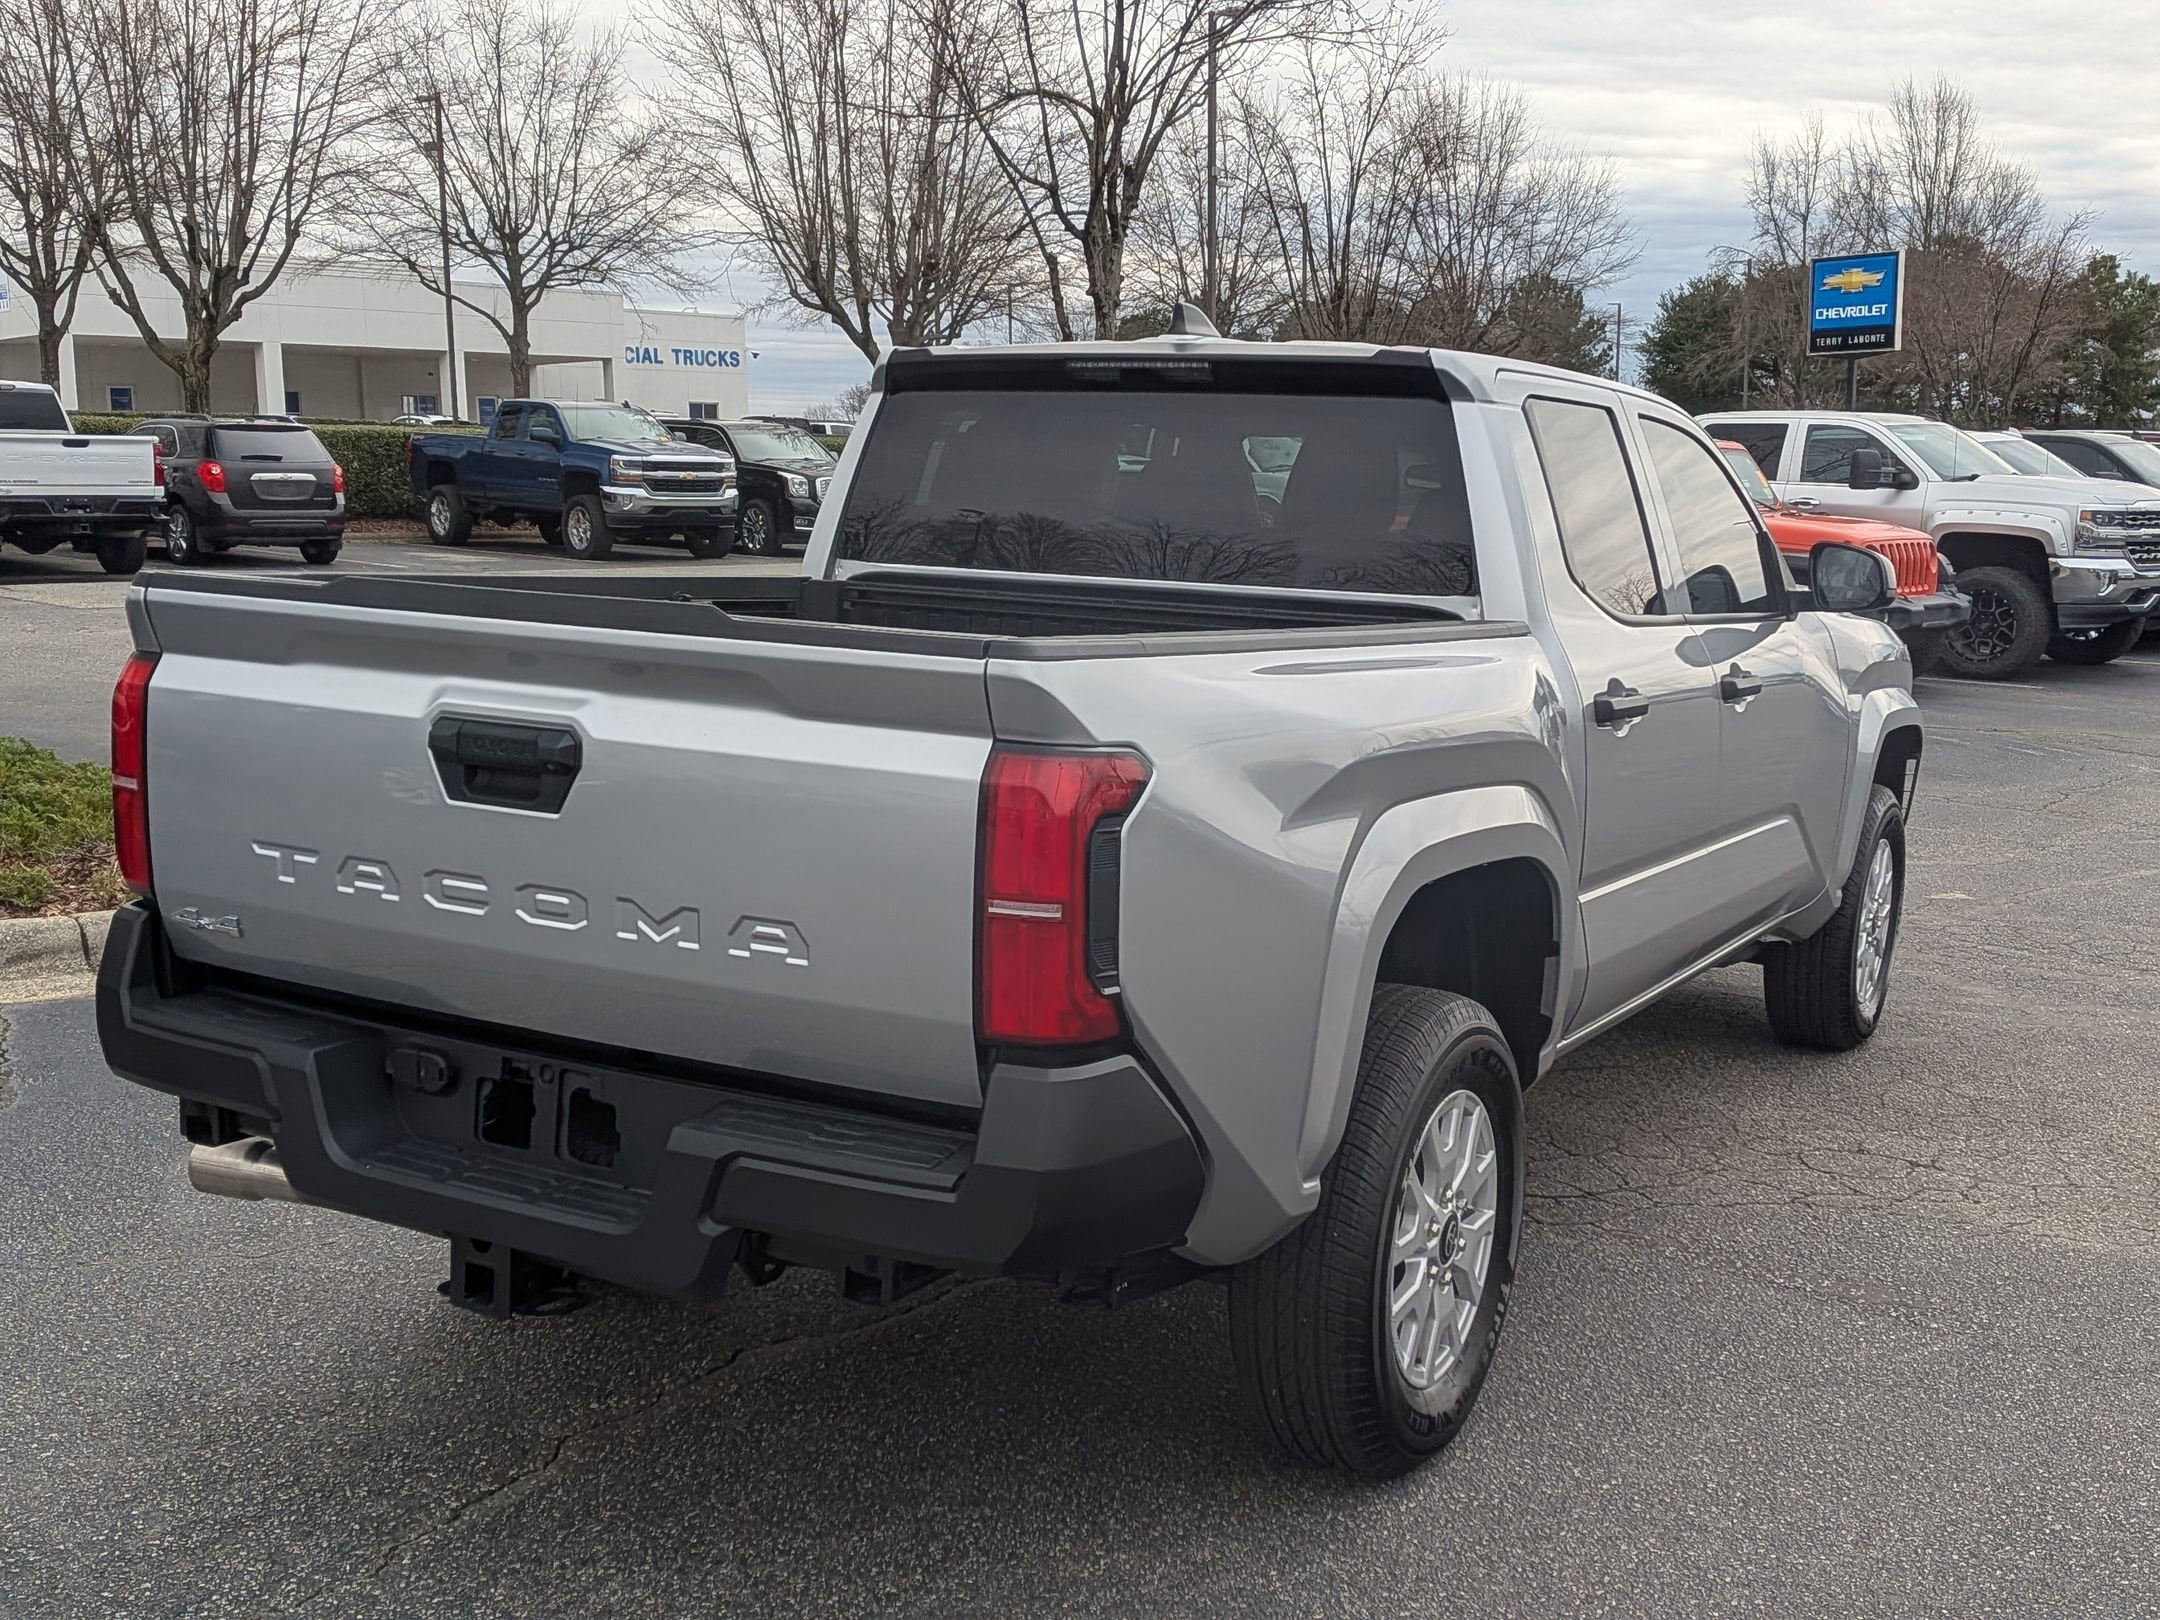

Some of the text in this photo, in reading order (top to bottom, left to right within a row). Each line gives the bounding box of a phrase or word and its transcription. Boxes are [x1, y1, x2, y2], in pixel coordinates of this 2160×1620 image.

[1815, 303, 1888, 320] CHEVROLET
[1816, 333, 1886, 347] TERRY LABONTE
[624, 346, 741, 368] CIAL TRUCKS
[250, 838, 809, 967] TACOMA
